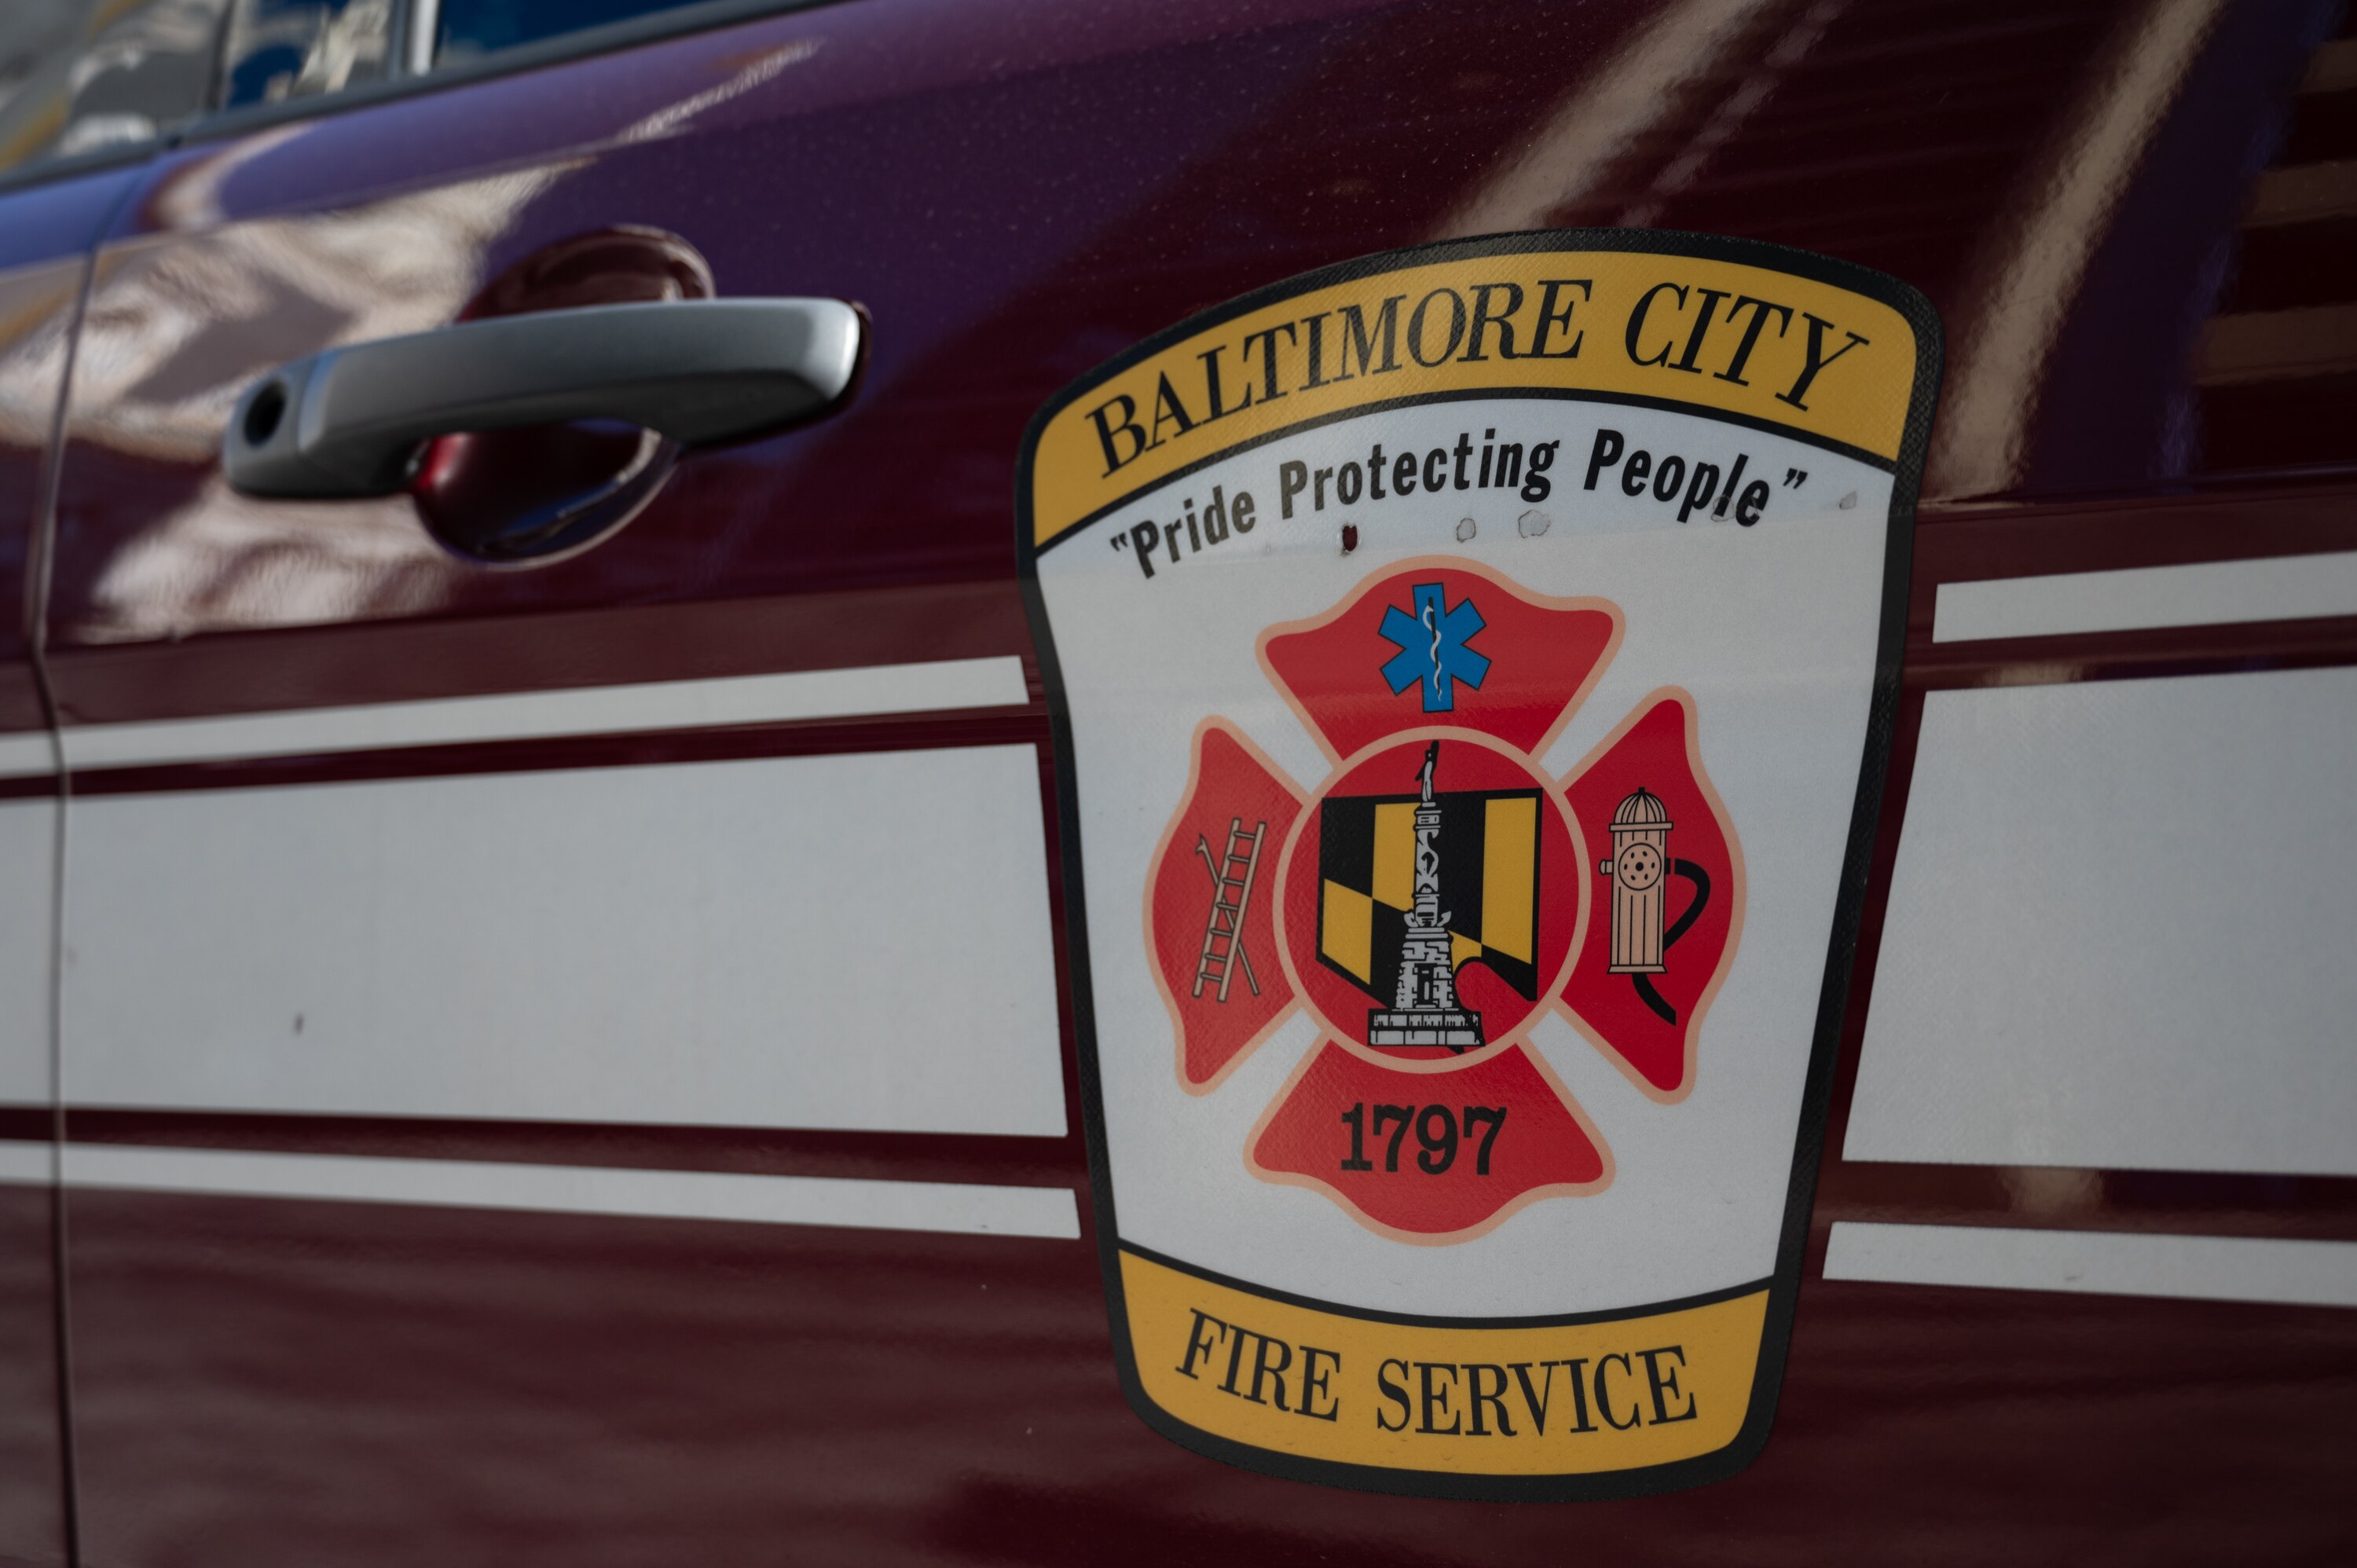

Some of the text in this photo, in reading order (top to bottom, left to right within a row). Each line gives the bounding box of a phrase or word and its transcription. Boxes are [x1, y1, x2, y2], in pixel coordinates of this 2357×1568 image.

[1084, 280, 1870, 480] BALTIMORE CITY
[1109, 428, 1808, 580] “Pride Protecting People”
[1340, 1102, 1507, 1175] 1797
[1175, 1307, 1698, 1438] FIRE SERVICE
